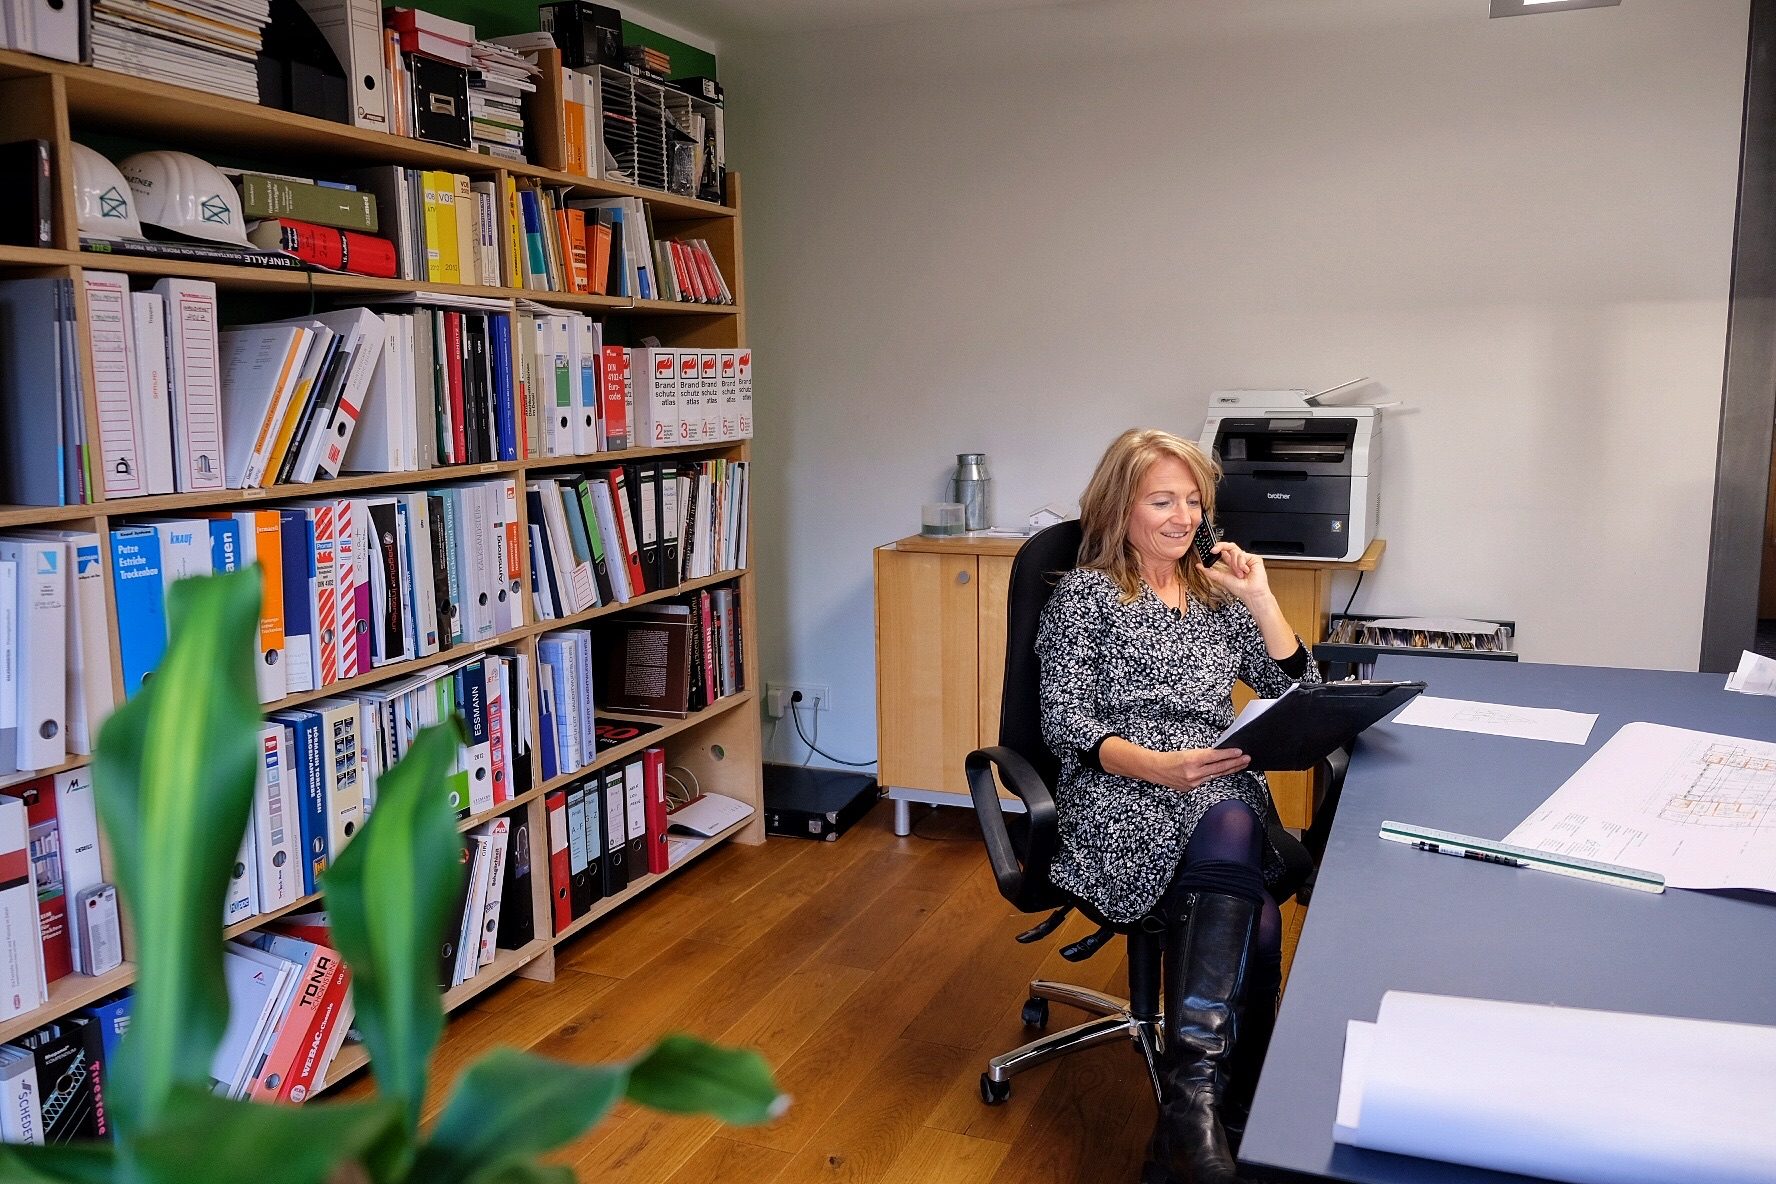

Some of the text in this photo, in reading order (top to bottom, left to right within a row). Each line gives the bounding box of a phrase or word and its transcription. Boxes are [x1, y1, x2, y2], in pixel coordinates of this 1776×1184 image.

[439, 193, 454, 204] VOB
[655, 381, 676, 389] Brand
[680, 381, 700, 389] Brand
[701, 380, 717, 388] Brand
[738, 378, 752, 386] Brand
[608, 393, 621, 401] codes
[680, 389, 700, 397] schutz
[721, 387, 736, 395] schutz
[680, 422, 688, 439] 3
[701, 421, 708, 435] 4
[722, 420, 729, 435] 5
[739, 416, 745, 431] 6
[656, 423, 664, 440] 2
[1267, 492, 1291, 500] brother
[170, 532, 193, 546] KNAUF
[118, 545, 139, 554] Putze
[223, 532, 235, 575] auen
[119, 556, 147, 567] Estriche
[496, 535, 504, 584] Armstrong
[120, 568, 159, 580] Trockenbau
[472, 686, 482, 737] ESSMANN
[313, 726, 321, 766] HÖRMANN
[299, 956, 332, 1008] TONA
[311, 959, 338, 1012] SCHORNSTEINE
[89, 1060, 106, 1137] Firestone
